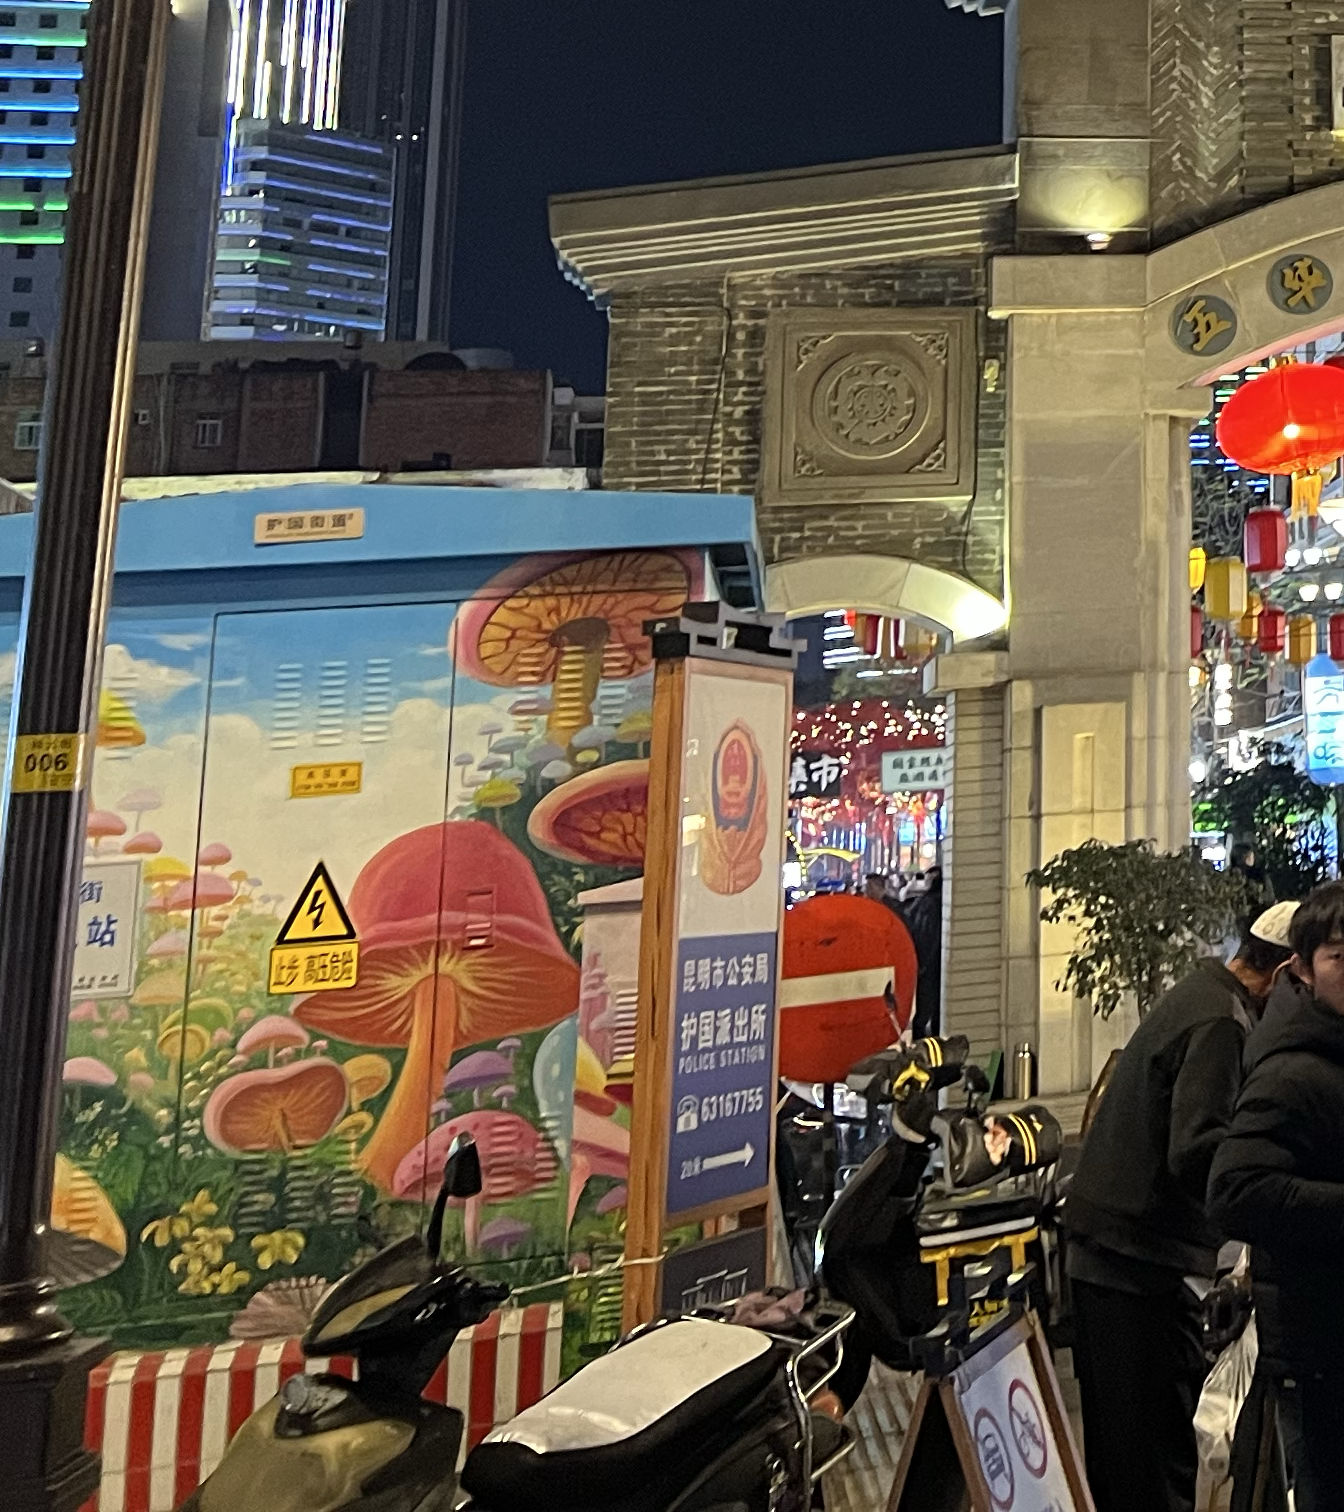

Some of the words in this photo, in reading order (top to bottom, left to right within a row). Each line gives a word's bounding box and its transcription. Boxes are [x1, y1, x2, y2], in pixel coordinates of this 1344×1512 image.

[24, 752, 69, 774] 006
[86, 914, 118, 947] 站
[303, 948, 354, 985] 高压危险
[682, 954, 768, 994] 昆明市公安局
[680, 1004, 767, 1053] 护国派出所
[678, 1051, 716, 1075] POLICE
[720, 1044, 766, 1067] STATION
[702, 1087, 764, 1123] 63167755
